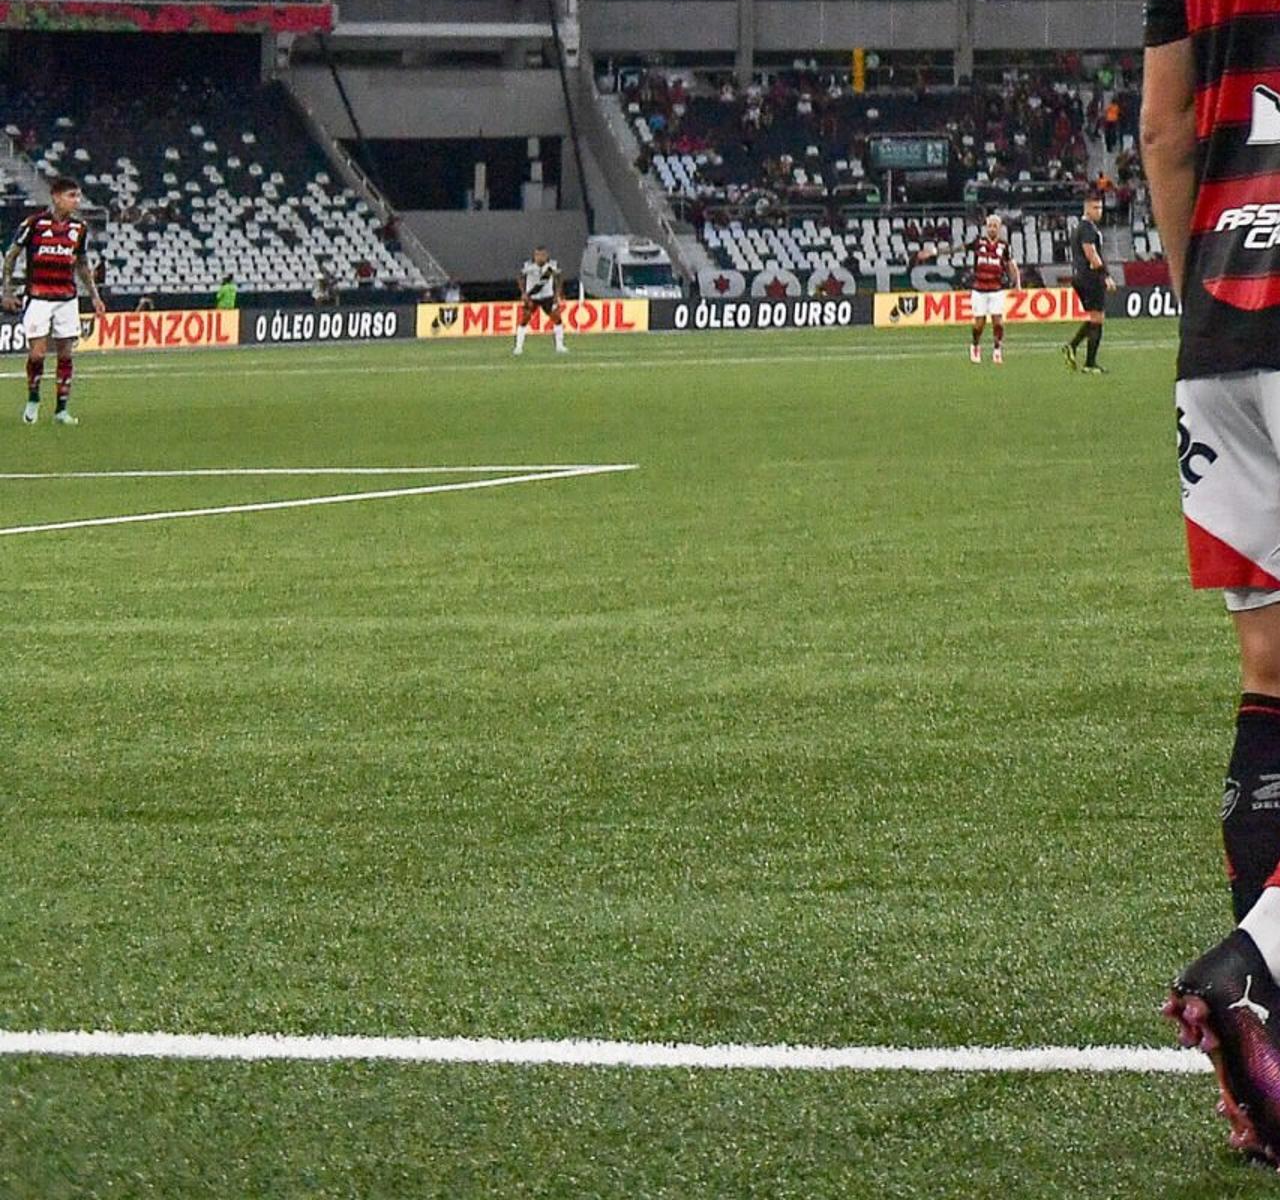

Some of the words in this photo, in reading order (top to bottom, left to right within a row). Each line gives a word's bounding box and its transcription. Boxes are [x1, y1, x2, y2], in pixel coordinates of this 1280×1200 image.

[675, 304, 688, 328] O
[695, 299, 751, 328] ÓLEO
[757, 302, 787, 328] DO
[794, 301, 851, 326] URSO
[924, 287, 1091, 323] MEZOIL
[1127, 291, 1141, 317] O
[98, 311, 230, 348] MENZOIL
[256, 315, 267, 341] O
[271, 310, 314, 340] ÓLEO
[319, 312, 343, 339] DO
[348, 311, 397, 337] URSO
